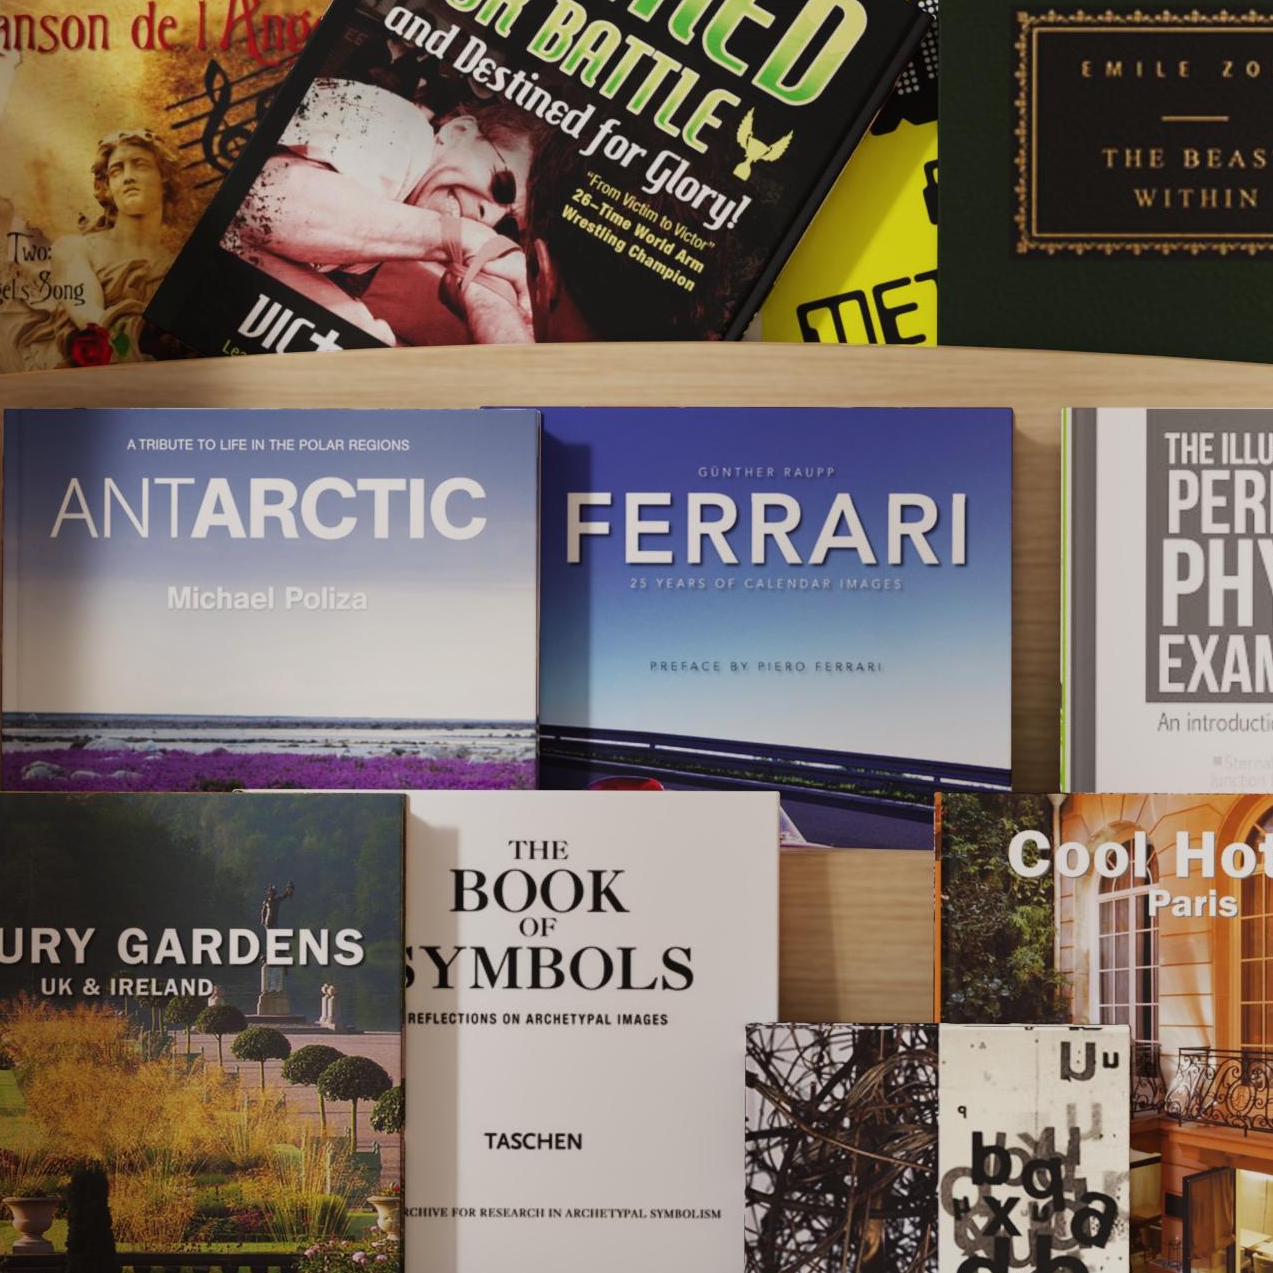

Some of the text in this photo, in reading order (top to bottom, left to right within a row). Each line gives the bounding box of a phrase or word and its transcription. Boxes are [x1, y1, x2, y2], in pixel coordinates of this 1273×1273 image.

[131, 1, 178, 52] de
[1081, 60, 1192, 78] EMILE
[384, 5, 752, 230] and Destined for Glory!
[1102, 147, 1166, 169] THE
[624, 192, 659, 223] Victim
[659, 214, 673, 231] to
[1133, 188, 1260, 209] WITHIN
[7, 231, 52, 264] Two:
[561, 204, 696, 292] Wrestling Champion
[633, 224, 676, 256] World
[676, 249, 705, 274] Arm
[30, 270, 87, 306] Song
[126, 438, 411, 451] A TRIBUTE TO LIFE IN THE POLAR REGIONS
[1165, 431, 1214, 465] THE
[698, 465, 836, 478] GÜNTHER RAUPP
[49, 476, 488, 541] ANTARCTIC
[566, 491, 968, 567] FERRARI
[630, 577, 904, 591] 25 YEARS OF CALENDAR IMAGES
[167, 585, 369, 612] Michael Poliza
[649, 660, 882, 673] PREFACE BY PIERO FERRARI
[1157, 713, 1181, 733] An
[508, 840, 570, 861] THE
[1008, 829, 1150, 880] Cool
[450, 868, 631, 914] BOOK
[1147, 889, 1239, 919] Paris
[519, 917, 558, 938] OF
[117, 928, 365, 967] GARDENS
[41, 977, 214, 998] UK & IRELAND
[408, 1012, 669, 1026] REFLECTIONS ON ARCHETYPAL IMAGES
[484, 1132, 583, 1151] TASCHEN
[451, 1207, 476, 1218] FOR
[479, 1207, 545, 1219] RESEARCH
[548, 1207, 562, 1219] IN
[565, 1207, 647, 1219] ARCHETYPAL
[649, 1207, 722, 1219] SYMBOLISM
